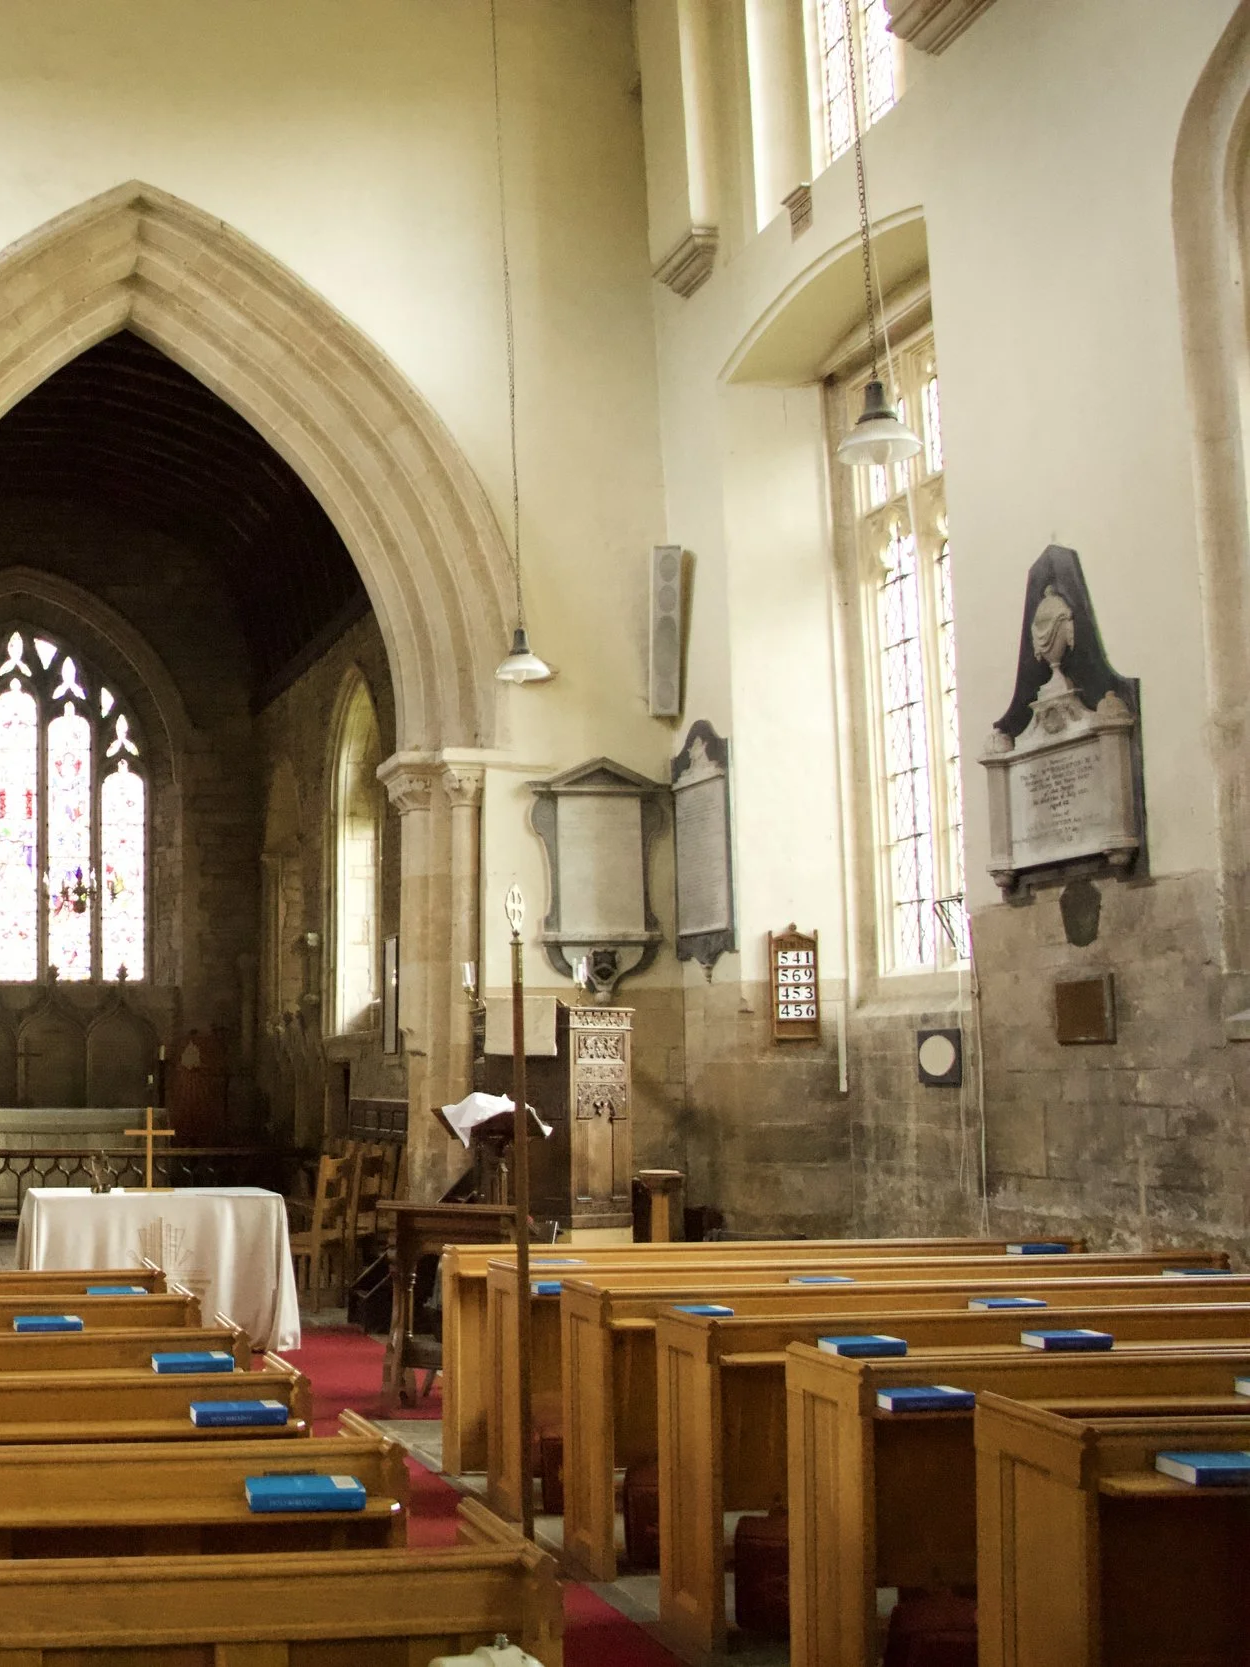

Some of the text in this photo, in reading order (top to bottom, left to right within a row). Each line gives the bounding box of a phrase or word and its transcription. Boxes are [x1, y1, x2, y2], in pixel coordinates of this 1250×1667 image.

[780, 951, 811, 964] 541
[780, 969, 813, 982] 569
[781, 987, 814, 999] 453
[781, 1005, 815, 1017] 456
